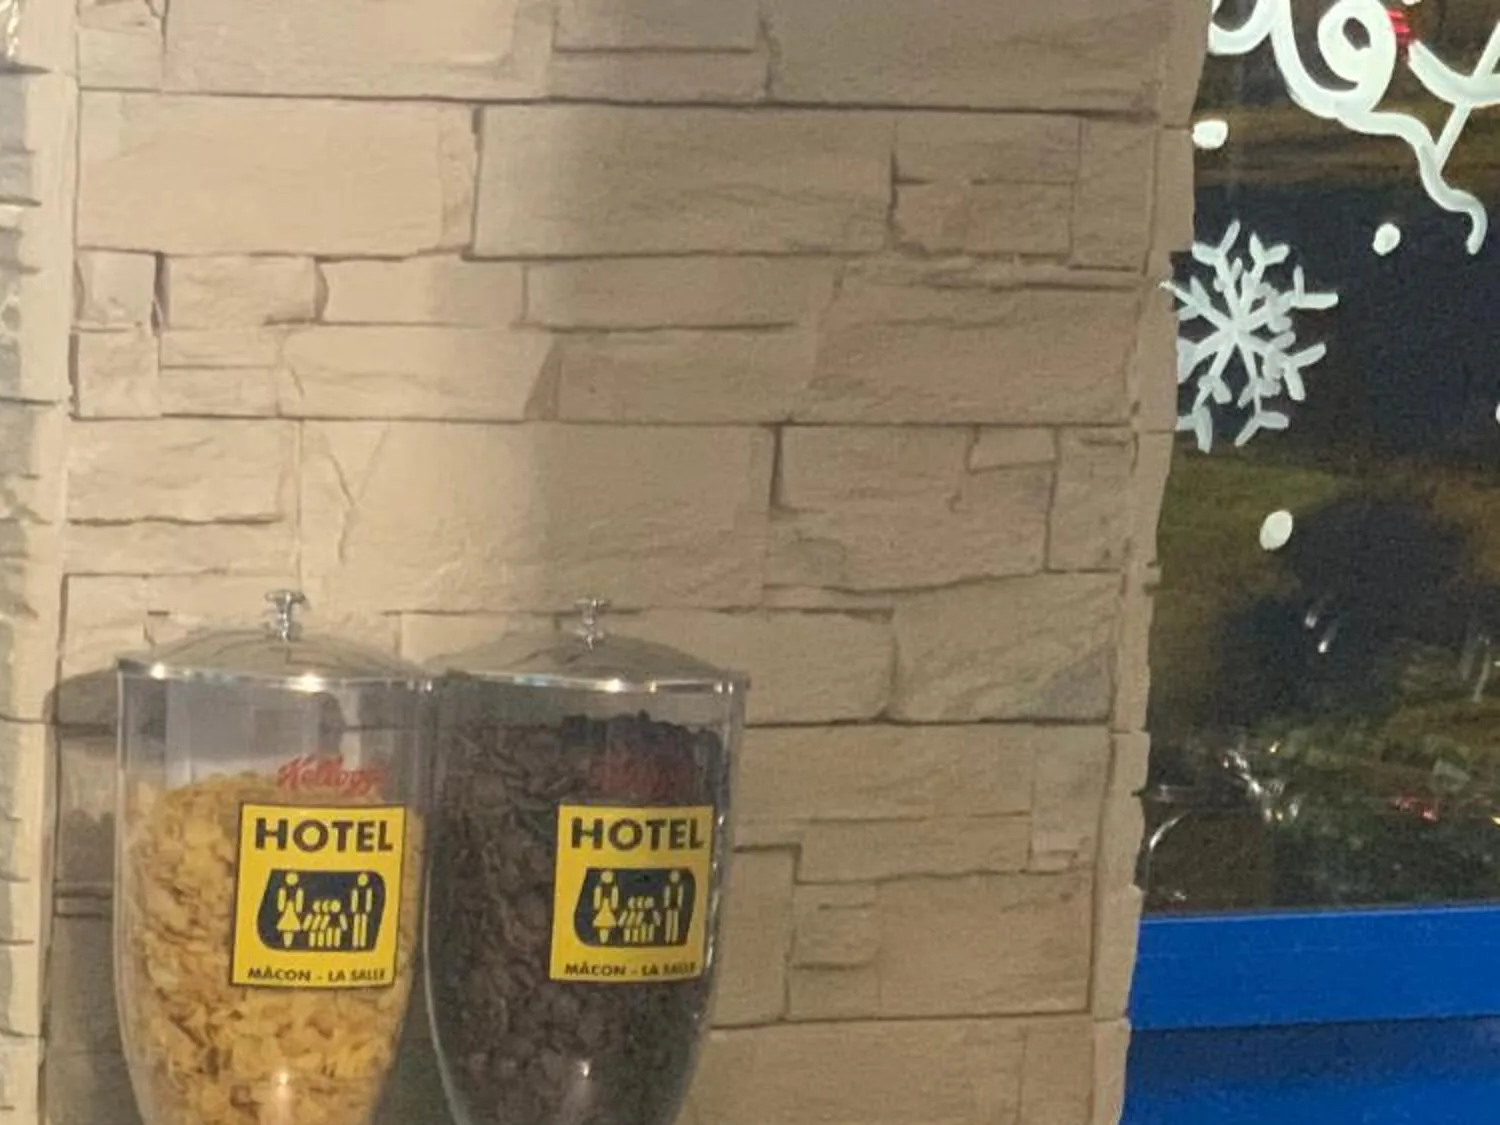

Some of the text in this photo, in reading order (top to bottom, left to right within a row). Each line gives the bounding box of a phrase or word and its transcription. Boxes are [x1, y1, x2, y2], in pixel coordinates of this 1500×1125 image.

[255, 817, 394, 852] HOTEL
[571, 816, 705, 851] HOTEL
[247, 965, 311, 981] MÂCON
[328, 969, 346, 982] LA
[641, 964, 658, 976] LA
